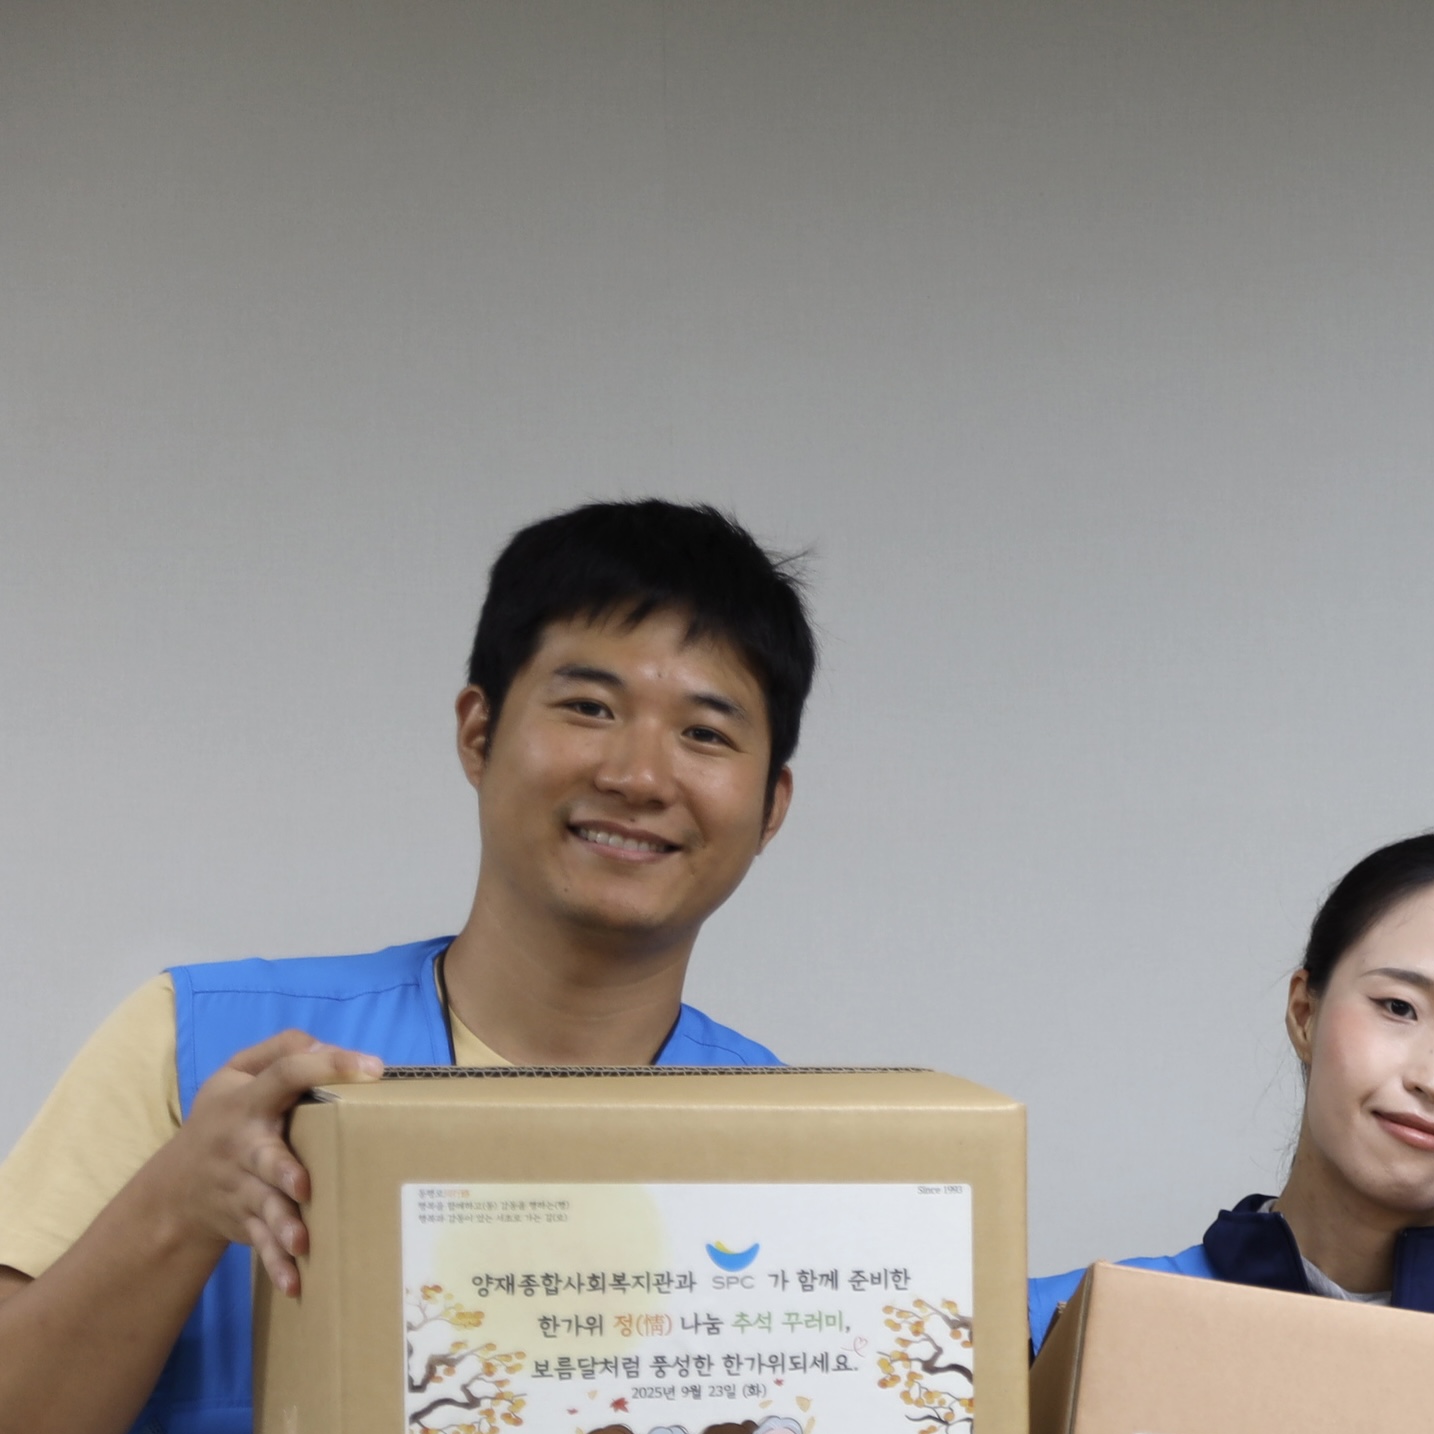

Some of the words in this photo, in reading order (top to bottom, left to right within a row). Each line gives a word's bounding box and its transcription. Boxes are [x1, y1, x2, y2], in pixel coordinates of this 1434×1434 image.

[917, 1186, 941, 1194] Since
[943, 1185, 963, 1194] 1993
[471, 1270, 697, 1298] 양재종합사회복지관과
[712, 1275, 754, 1290] SPC
[768, 1269, 790, 1291] 가
[796, 1269, 838, 1292] 함께
[848, 1268, 911, 1292] 준비한
[538, 1314, 603, 1338] 한가위
[613, 1313, 673, 1337] 정(情)
[680, 1312, 724, 1336] 나눔
[731, 1311, 772, 1334] 추석
[781, 1310, 851, 1334] 꾸러미,
[532, 1355, 640, 1381] 보름달처럼
[649, 1354, 715, 1379] 풍성한
[722, 1351, 858, 1376] 한가위되세요.
[632, 1385, 676, 1401] 2025년
[681, 1385, 702, 1400] 9월
[708, 1383, 736, 1399] 23일
[742, 1383, 767, 1398] (화)
